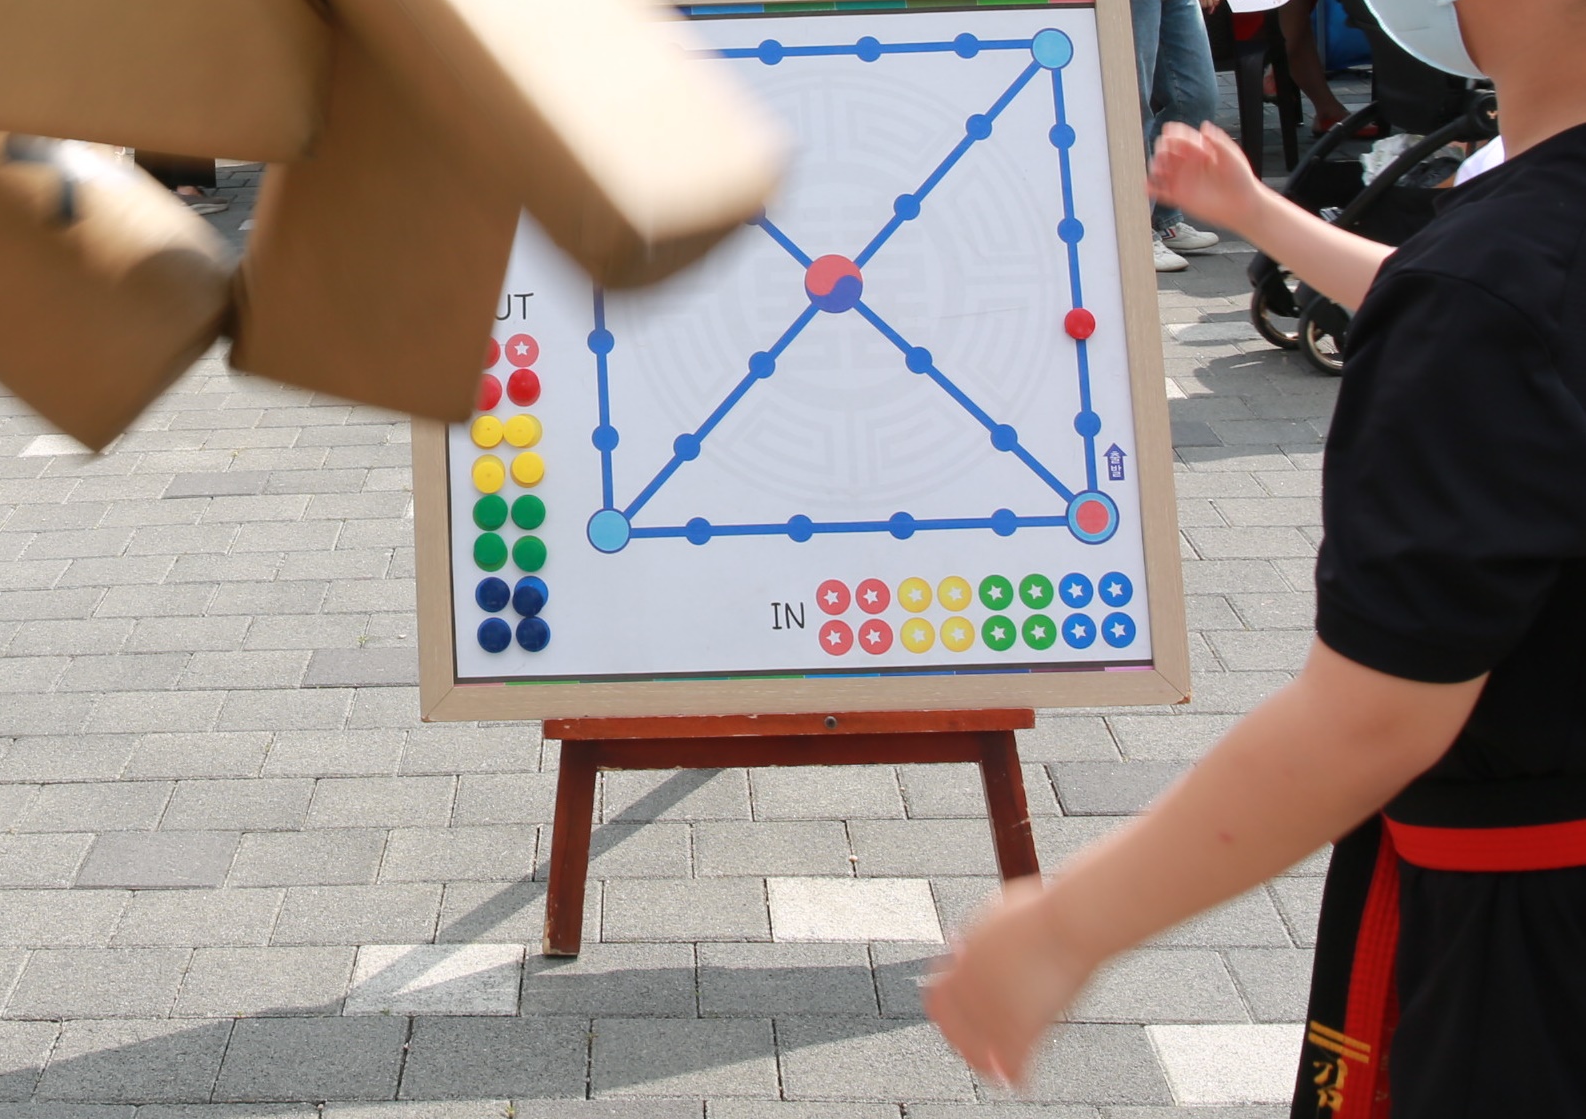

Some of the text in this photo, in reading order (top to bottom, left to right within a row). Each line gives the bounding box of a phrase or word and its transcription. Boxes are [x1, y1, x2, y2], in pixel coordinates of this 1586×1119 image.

[494, 292, 535, 321] UT
[1109, 450, 1123, 478] 출발
[770, 601, 805, 630] IN
